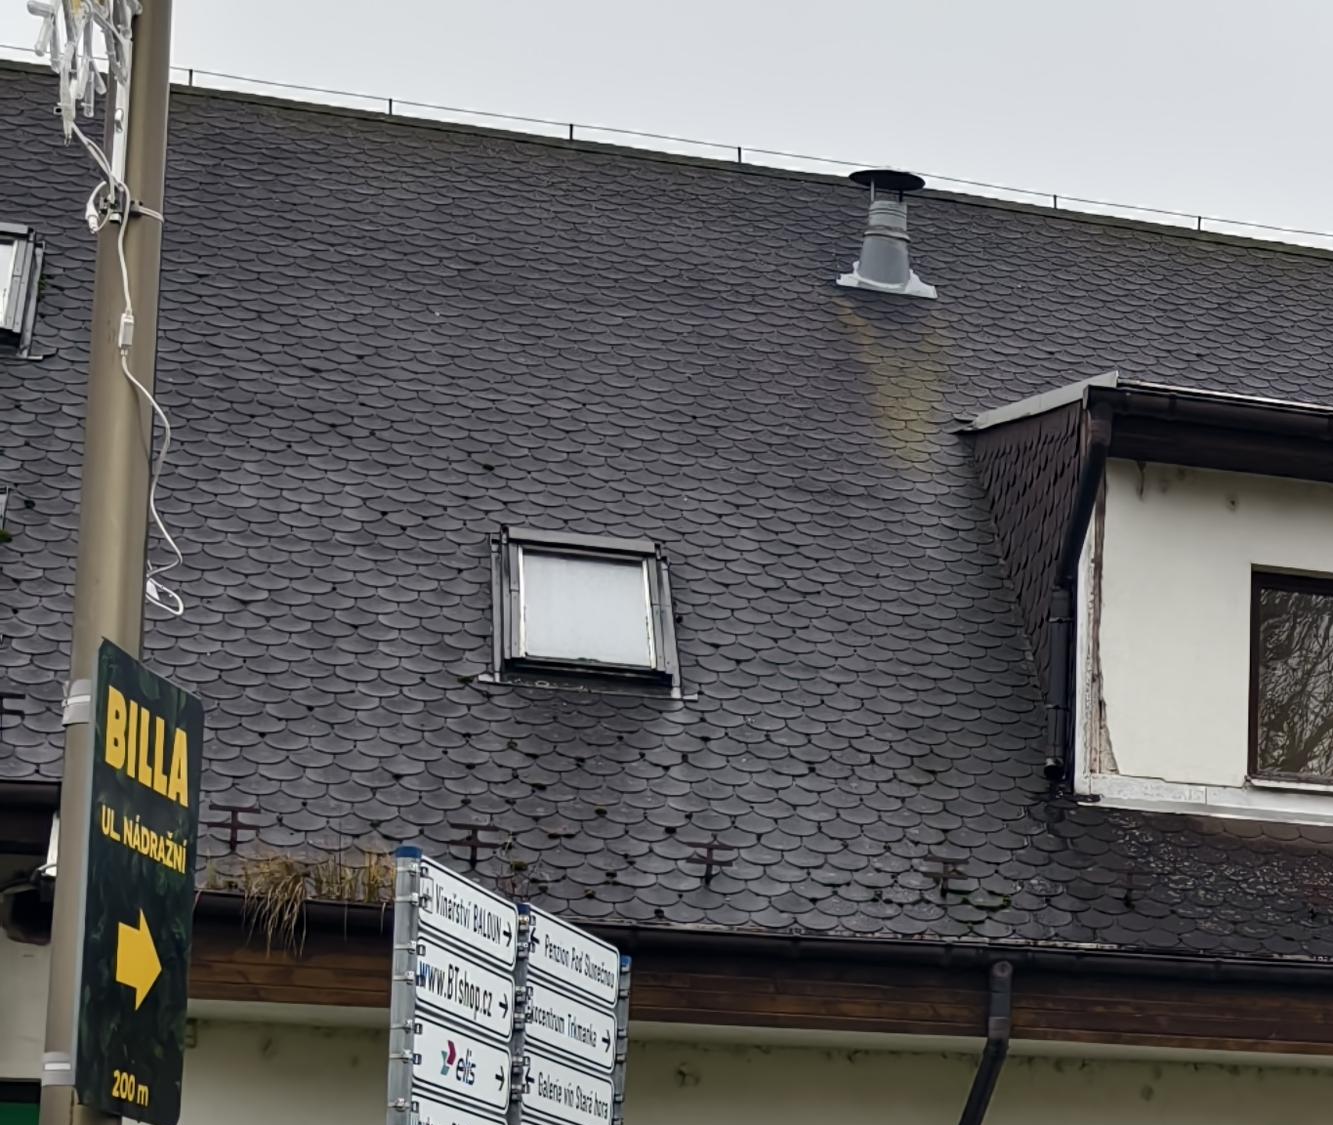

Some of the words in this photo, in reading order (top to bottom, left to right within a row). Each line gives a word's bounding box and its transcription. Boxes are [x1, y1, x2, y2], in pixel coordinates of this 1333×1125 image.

[105, 685, 189, 807] BILLA
[124, 814, 187, 874] NÁDRAŽNÍ
[435, 883, 472, 929] Vinařství
[544, 933, 570, 967] Penzion
[571, 947, 584, 973] Pod
[418, 960, 494, 1020] www.BTshop.cz
[111, 1070, 136, 1104] 200
[136, 1081, 150, 1107] m
[455, 1048, 477, 1086] elis
[538, 1071, 563, 1103] Galerie
[575, 1085, 593, 1115] Stará
[593, 1091, 608, 1120] hora
